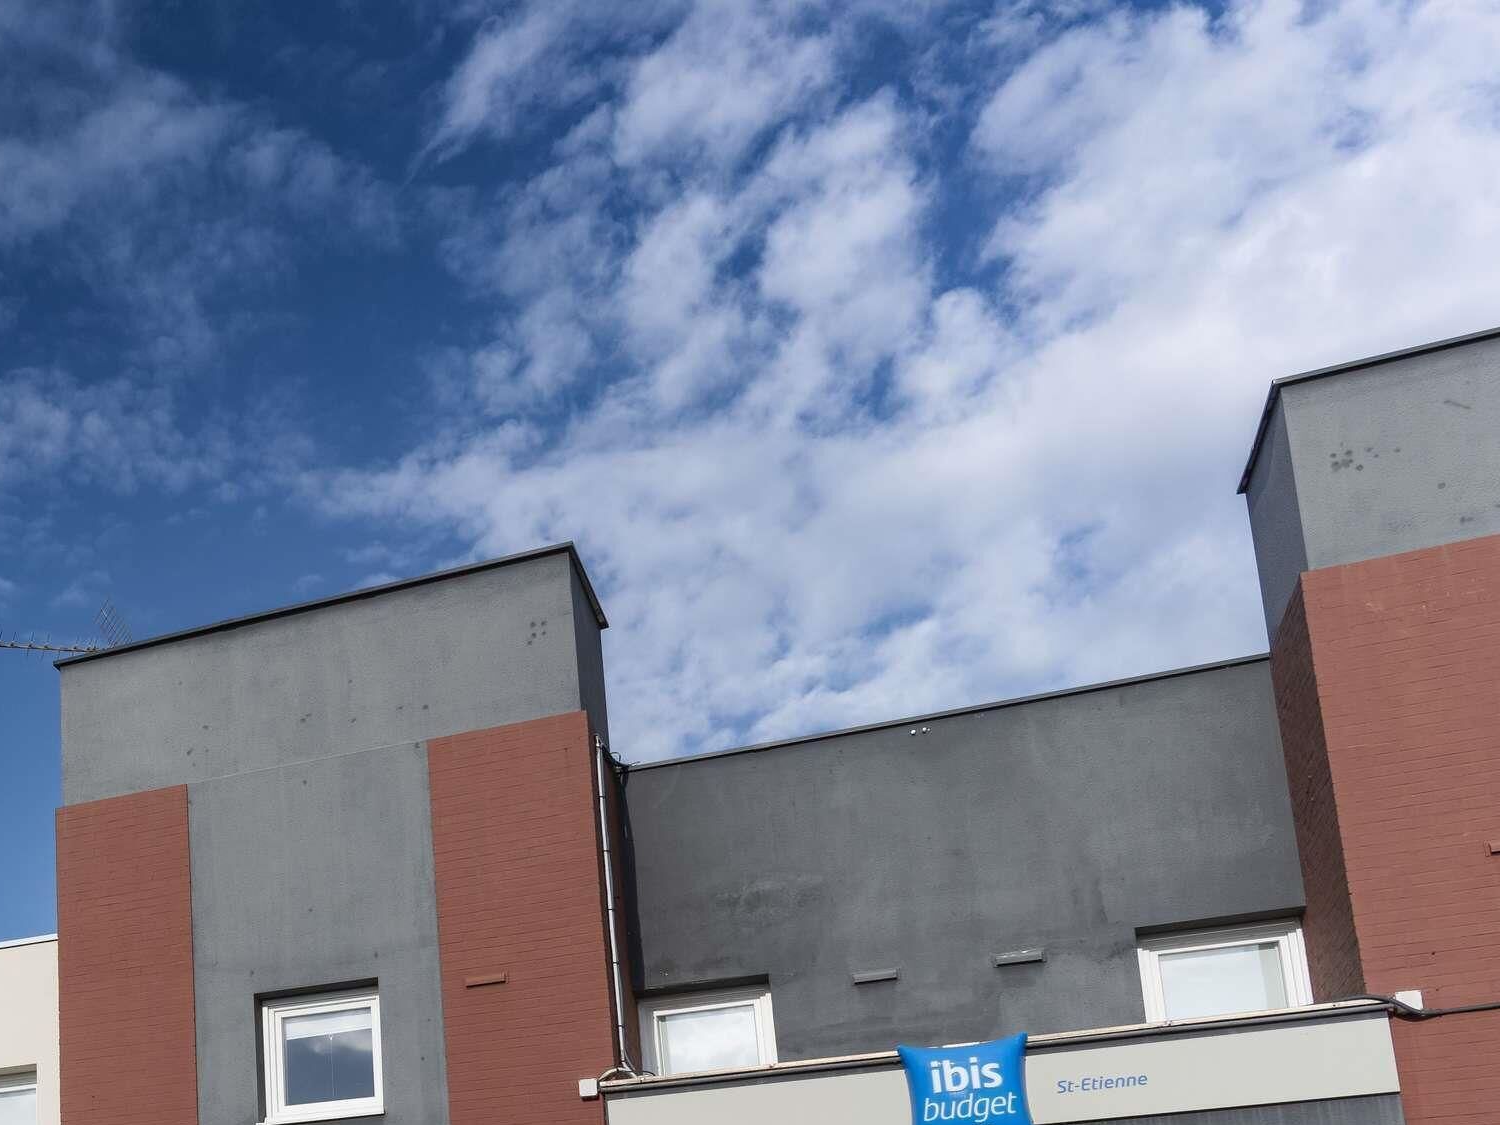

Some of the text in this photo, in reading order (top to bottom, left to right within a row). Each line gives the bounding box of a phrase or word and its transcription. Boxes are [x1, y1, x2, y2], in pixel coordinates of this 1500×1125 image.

[930, 1056, 1003, 1094] ibis
[1057, 1073, 1149, 1094] St-Etienne
[923, 1091, 1018, 1123] budget
